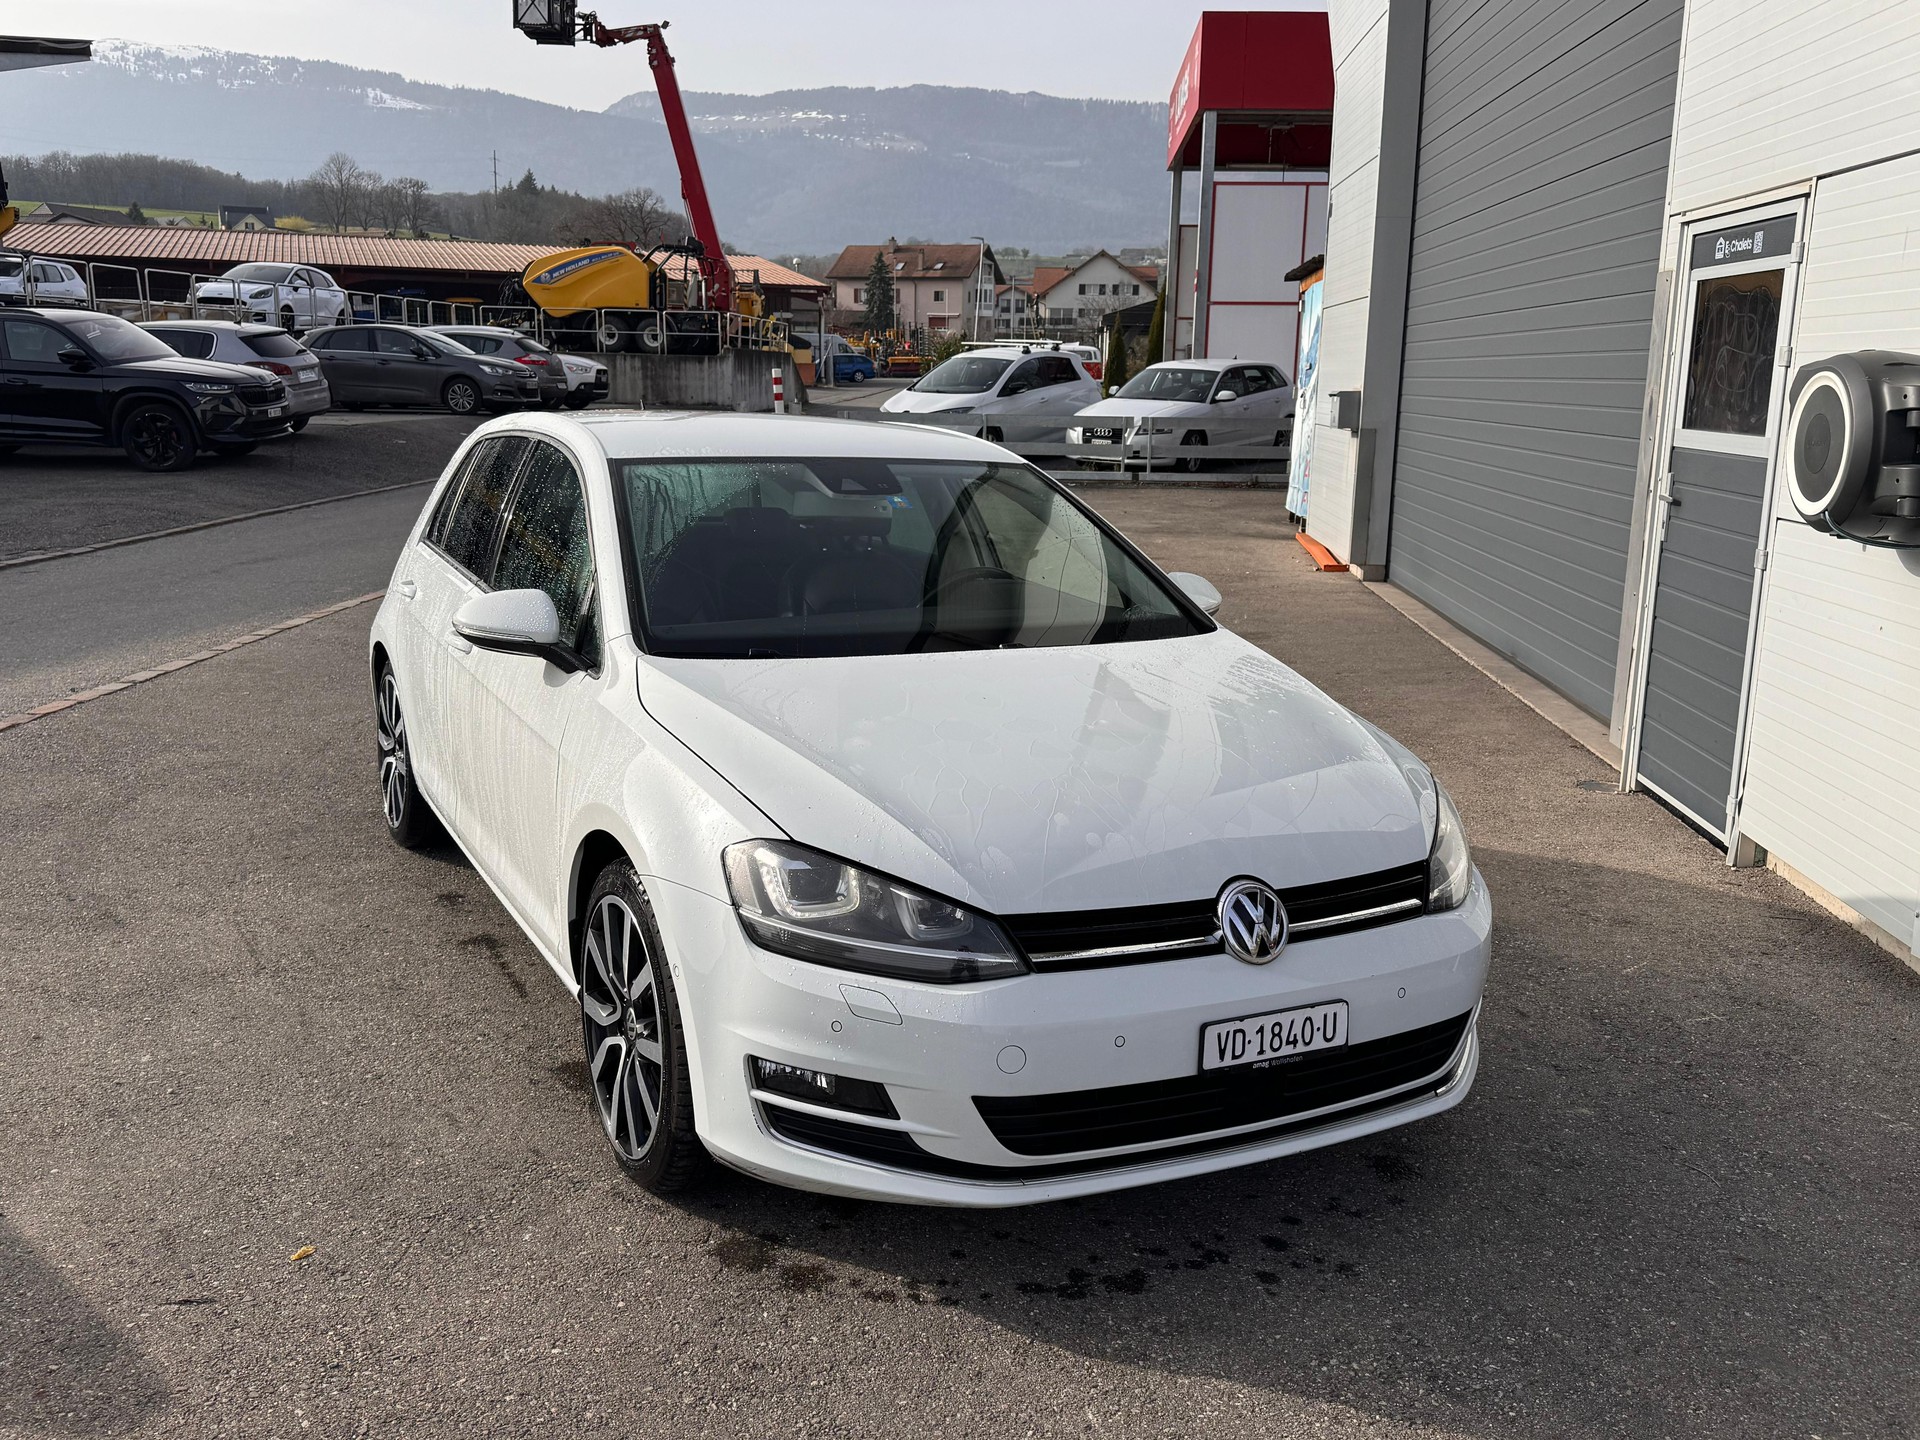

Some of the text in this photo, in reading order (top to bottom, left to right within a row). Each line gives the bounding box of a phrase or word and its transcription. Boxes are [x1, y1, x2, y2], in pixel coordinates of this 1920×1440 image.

[1731, 237, 1753, 252] Chalets
[552, 258, 591, 279] NEW HOLLAND
[1252, 1060, 1270, 1069] amag
